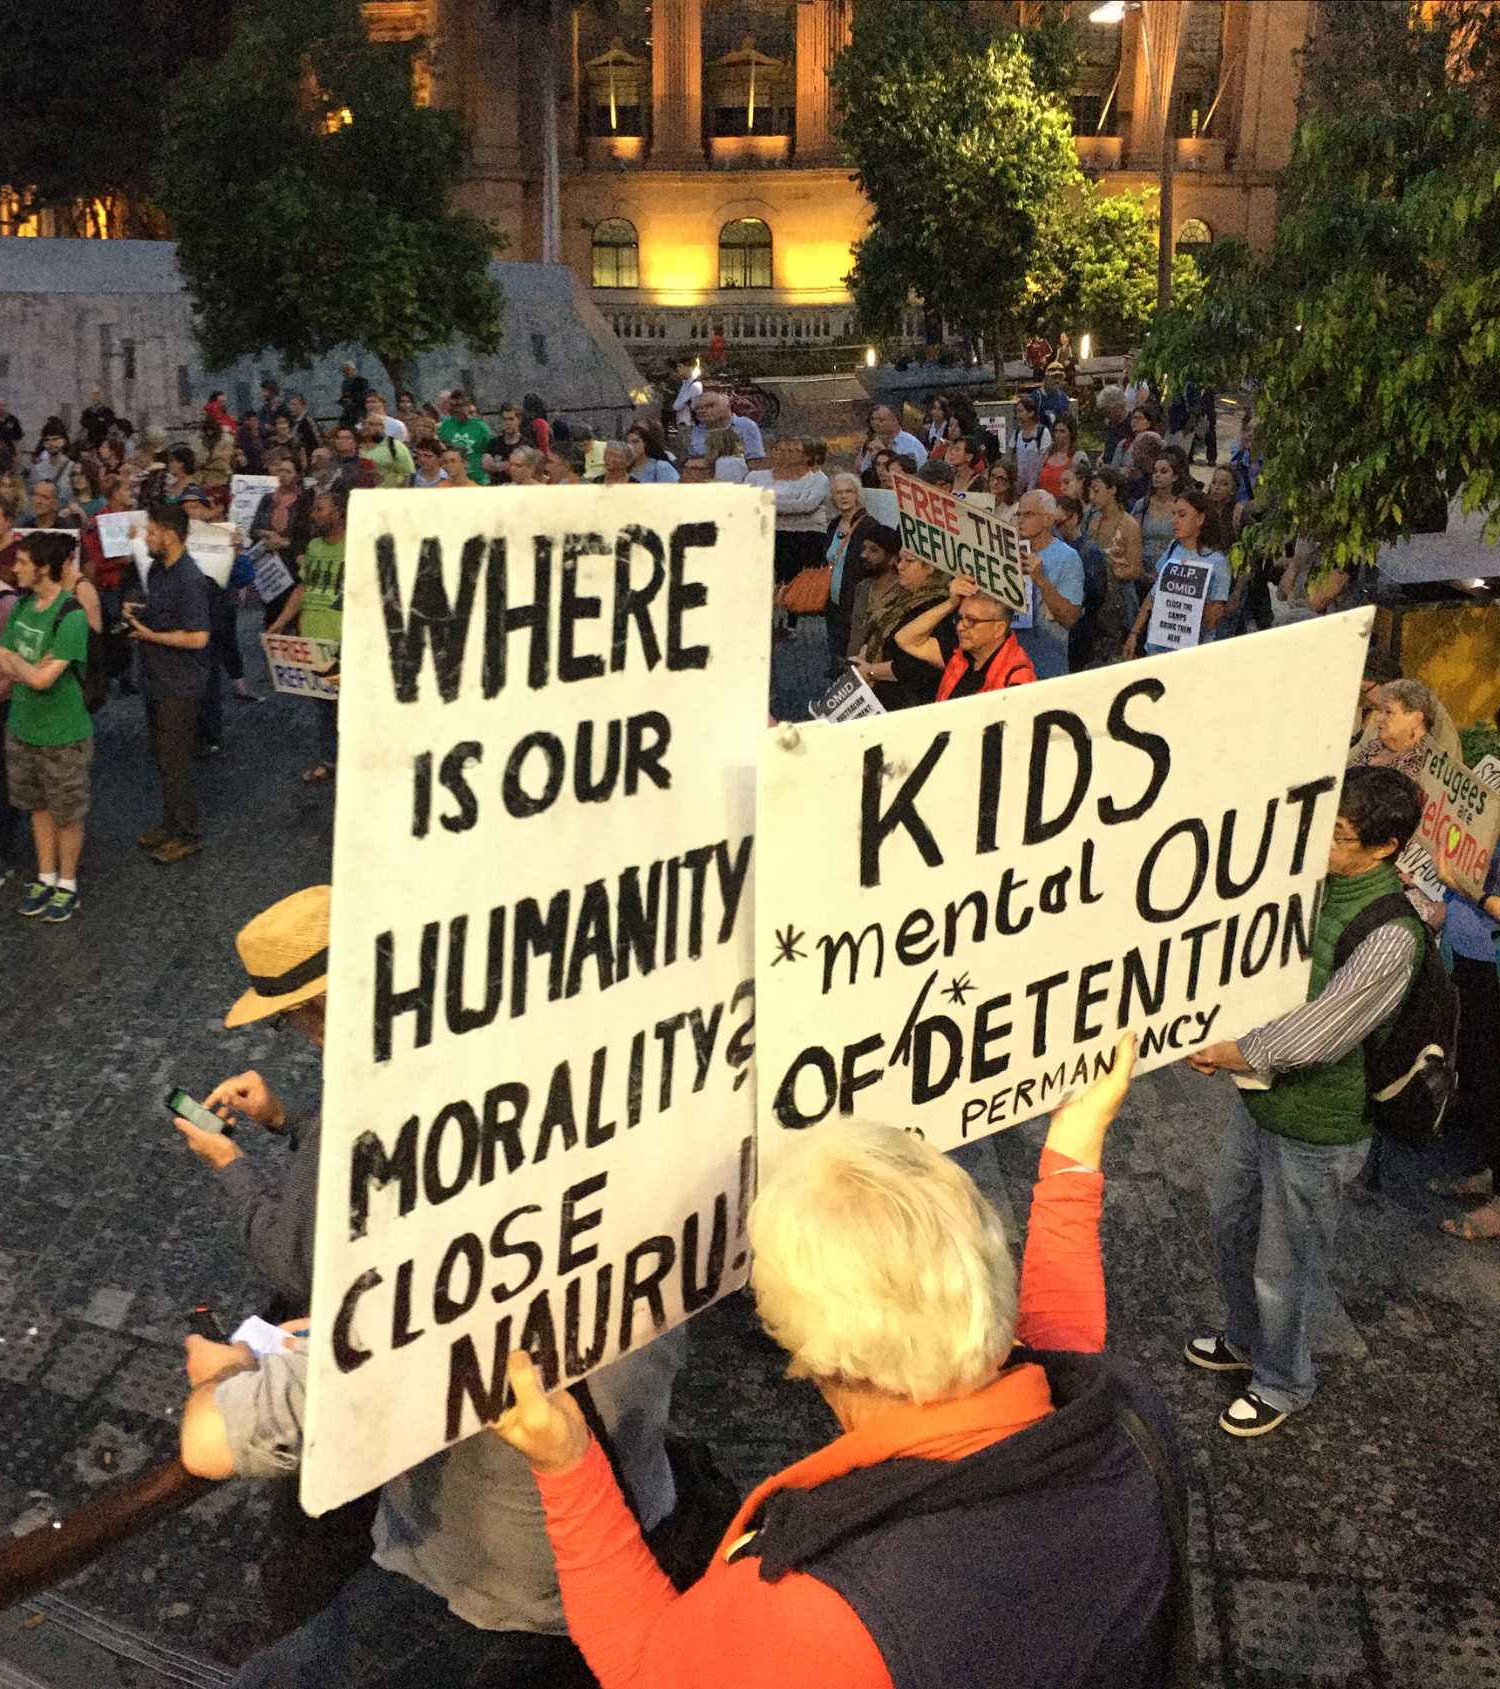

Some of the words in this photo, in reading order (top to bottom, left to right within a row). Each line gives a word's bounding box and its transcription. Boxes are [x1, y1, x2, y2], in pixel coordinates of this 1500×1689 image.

[893, 474, 960, 536] FREE
[967, 511, 1018, 563] THE
[900, 511, 1024, 608] REFUGEES
[267, 638, 313, 665] FREE
[375, 521, 718, 705] WHERE
[1166, 581, 1196, 596] OMID
[826, 682, 854, 709] OMID
[411, 740, 483, 839] IS
[503, 711, 672, 819] OUR
[860, 677, 1171, 889] KIDS
[1417, 790, 1492, 886] elcome
[1421, 748, 1488, 815] refugees
[1457, 804, 1473, 826] are
[1135, 775, 1338, 925] OUT
[373, 835, 754, 1063] HUMANITY
[771, 1032, 886, 1131] OF
[911, 877, 1324, 1106] DETENTION
[348, 978, 756, 1243] MORALITY?
[961, 1004, 1221, 1139] PERMANNCY
[332, 1171, 608, 1375] CLOSE
[444, 1135, 754, 1443] NAURU!
